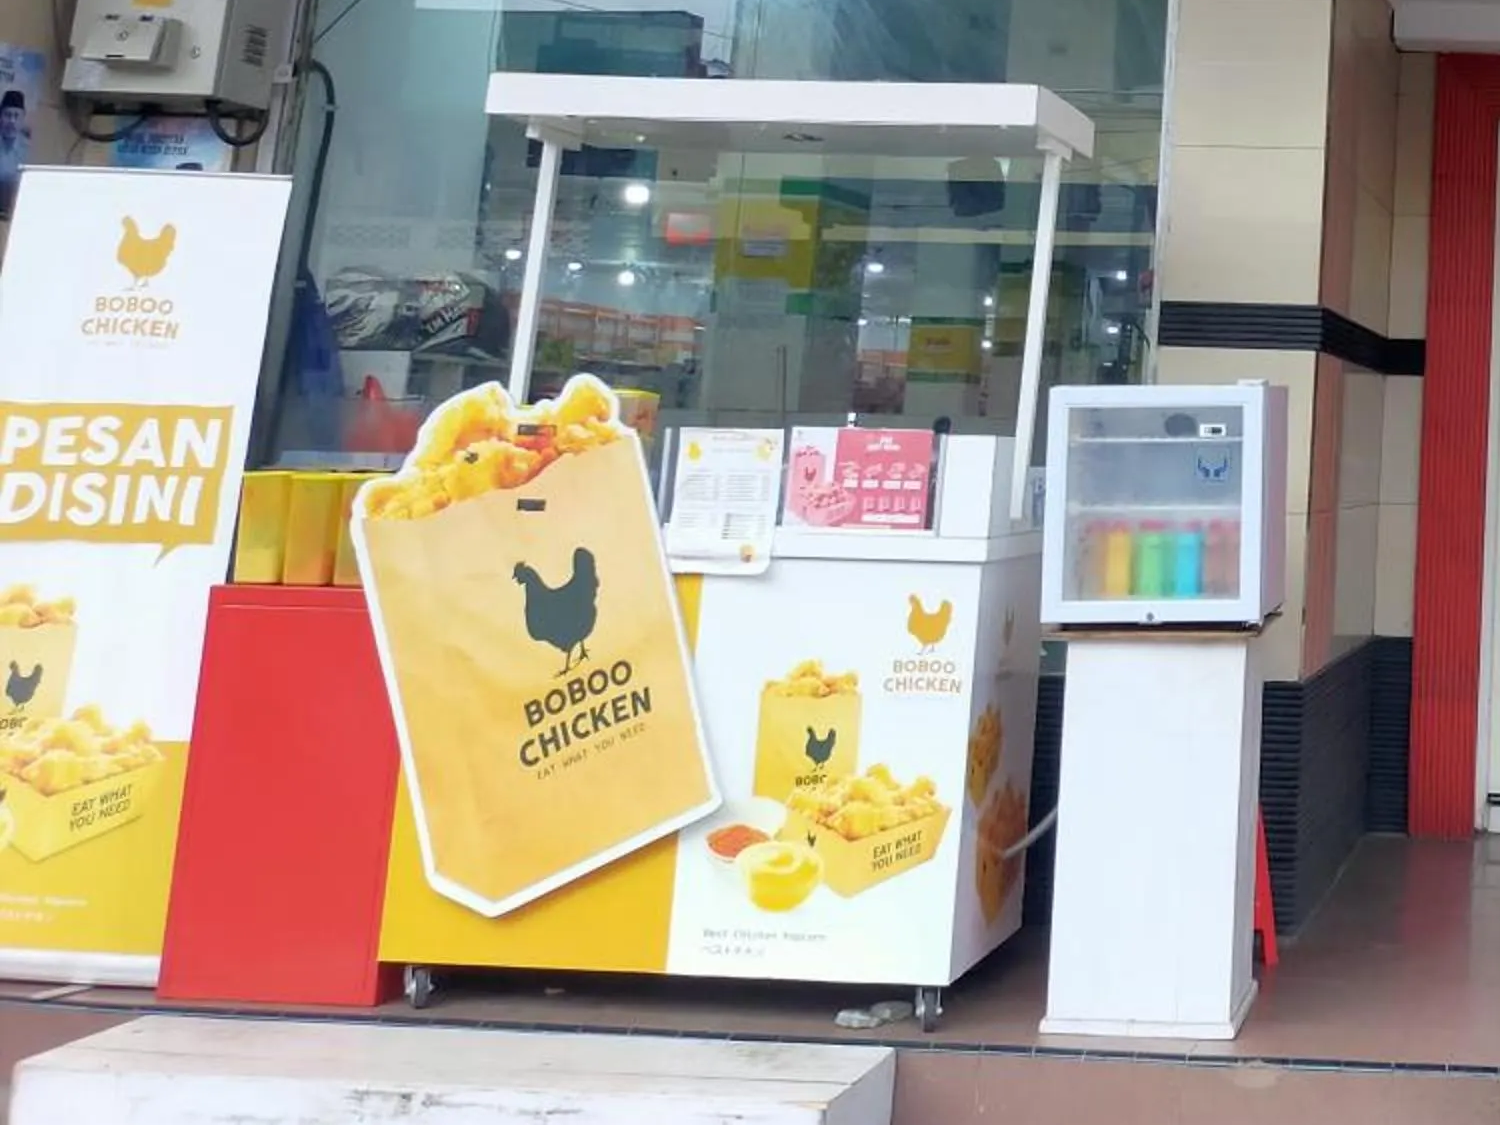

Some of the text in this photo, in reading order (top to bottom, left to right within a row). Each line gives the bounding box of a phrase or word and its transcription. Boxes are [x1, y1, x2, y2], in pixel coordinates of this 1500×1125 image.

[95, 295, 174, 315] BOBOO
[81, 317, 180, 339] CHICKEN
[0, 415, 223, 468] PESAN
[0, 471, 204, 526] DISINI
[893, 660, 955, 674] BOBOO
[524, 660, 632, 727] BOBOO
[883, 677, 962, 693] CHICKEN
[519, 686, 652, 767] CHICKEN
[71, 797, 96, 817] EAT
[69, 811, 96, 832] YOU
[873, 842, 892, 859] EAT
[871, 854, 893, 872] YOU
